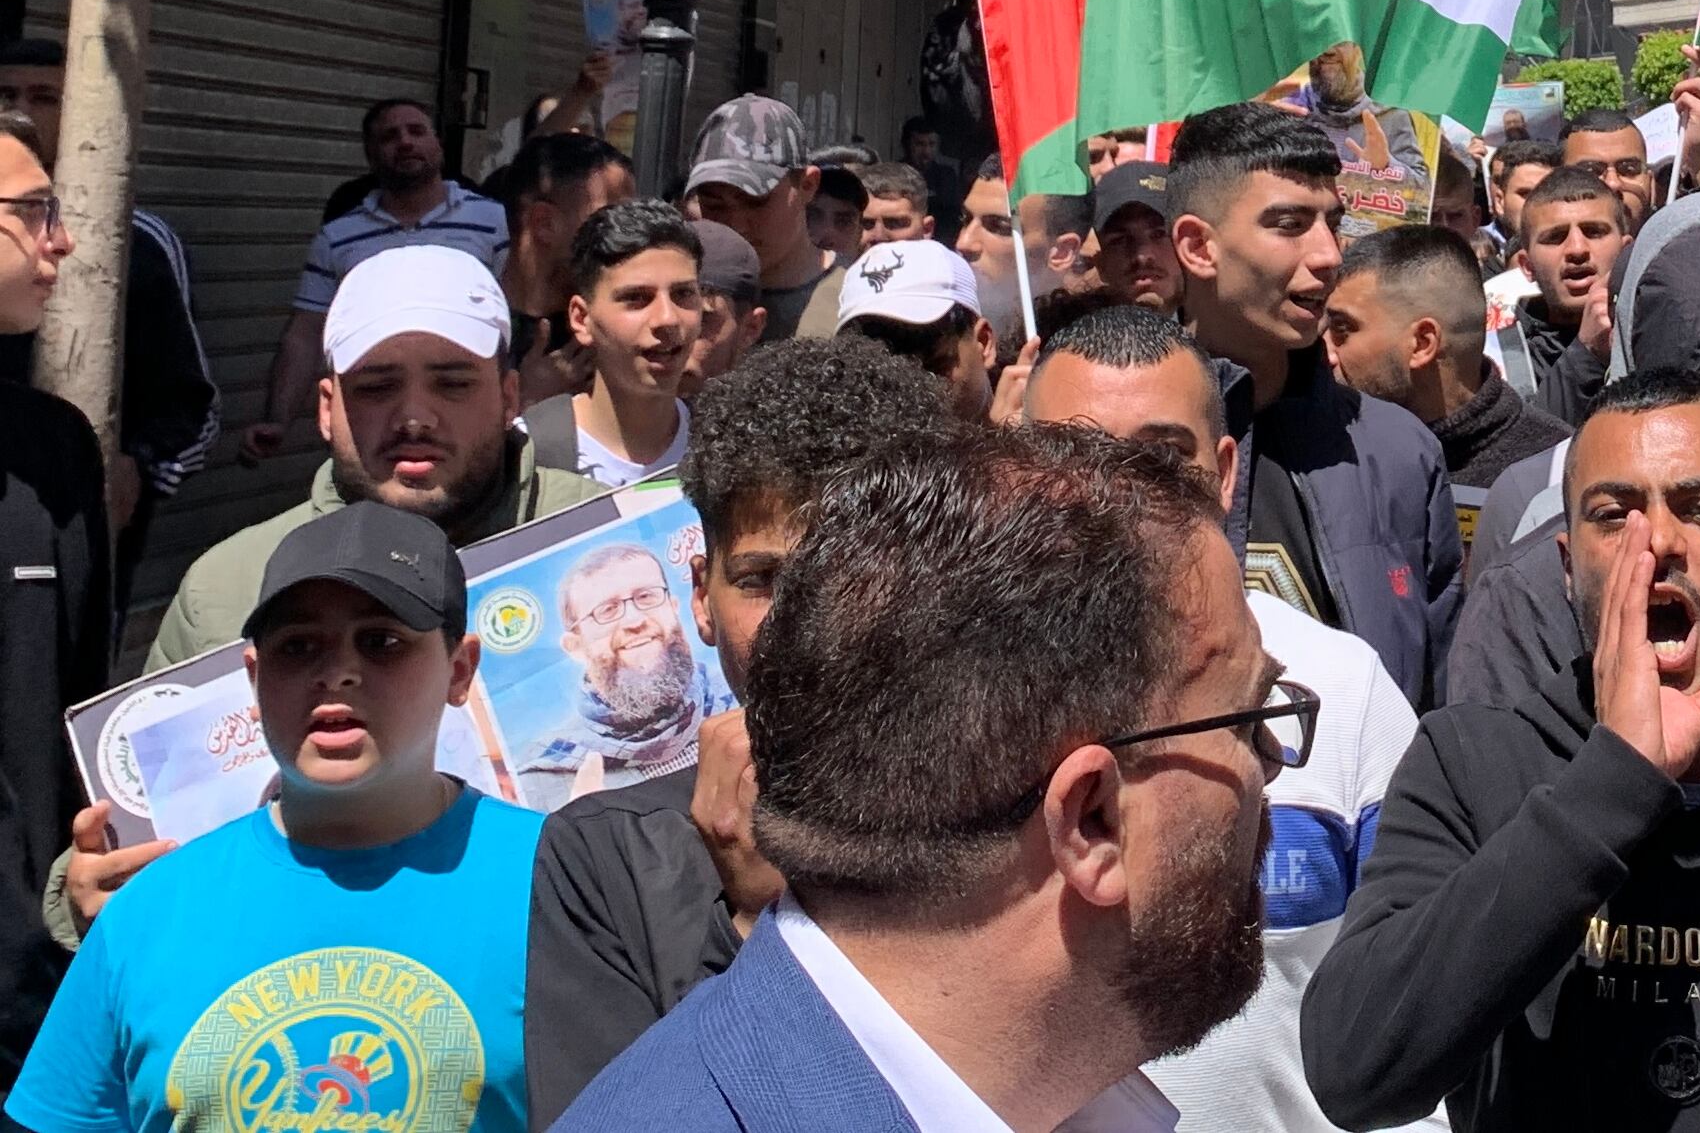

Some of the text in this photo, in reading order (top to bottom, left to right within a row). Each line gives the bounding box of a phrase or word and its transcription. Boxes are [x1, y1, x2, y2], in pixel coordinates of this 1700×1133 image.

[1351, 187, 1408, 215] خضر
[226, 959, 446, 1029] NEW YORK
